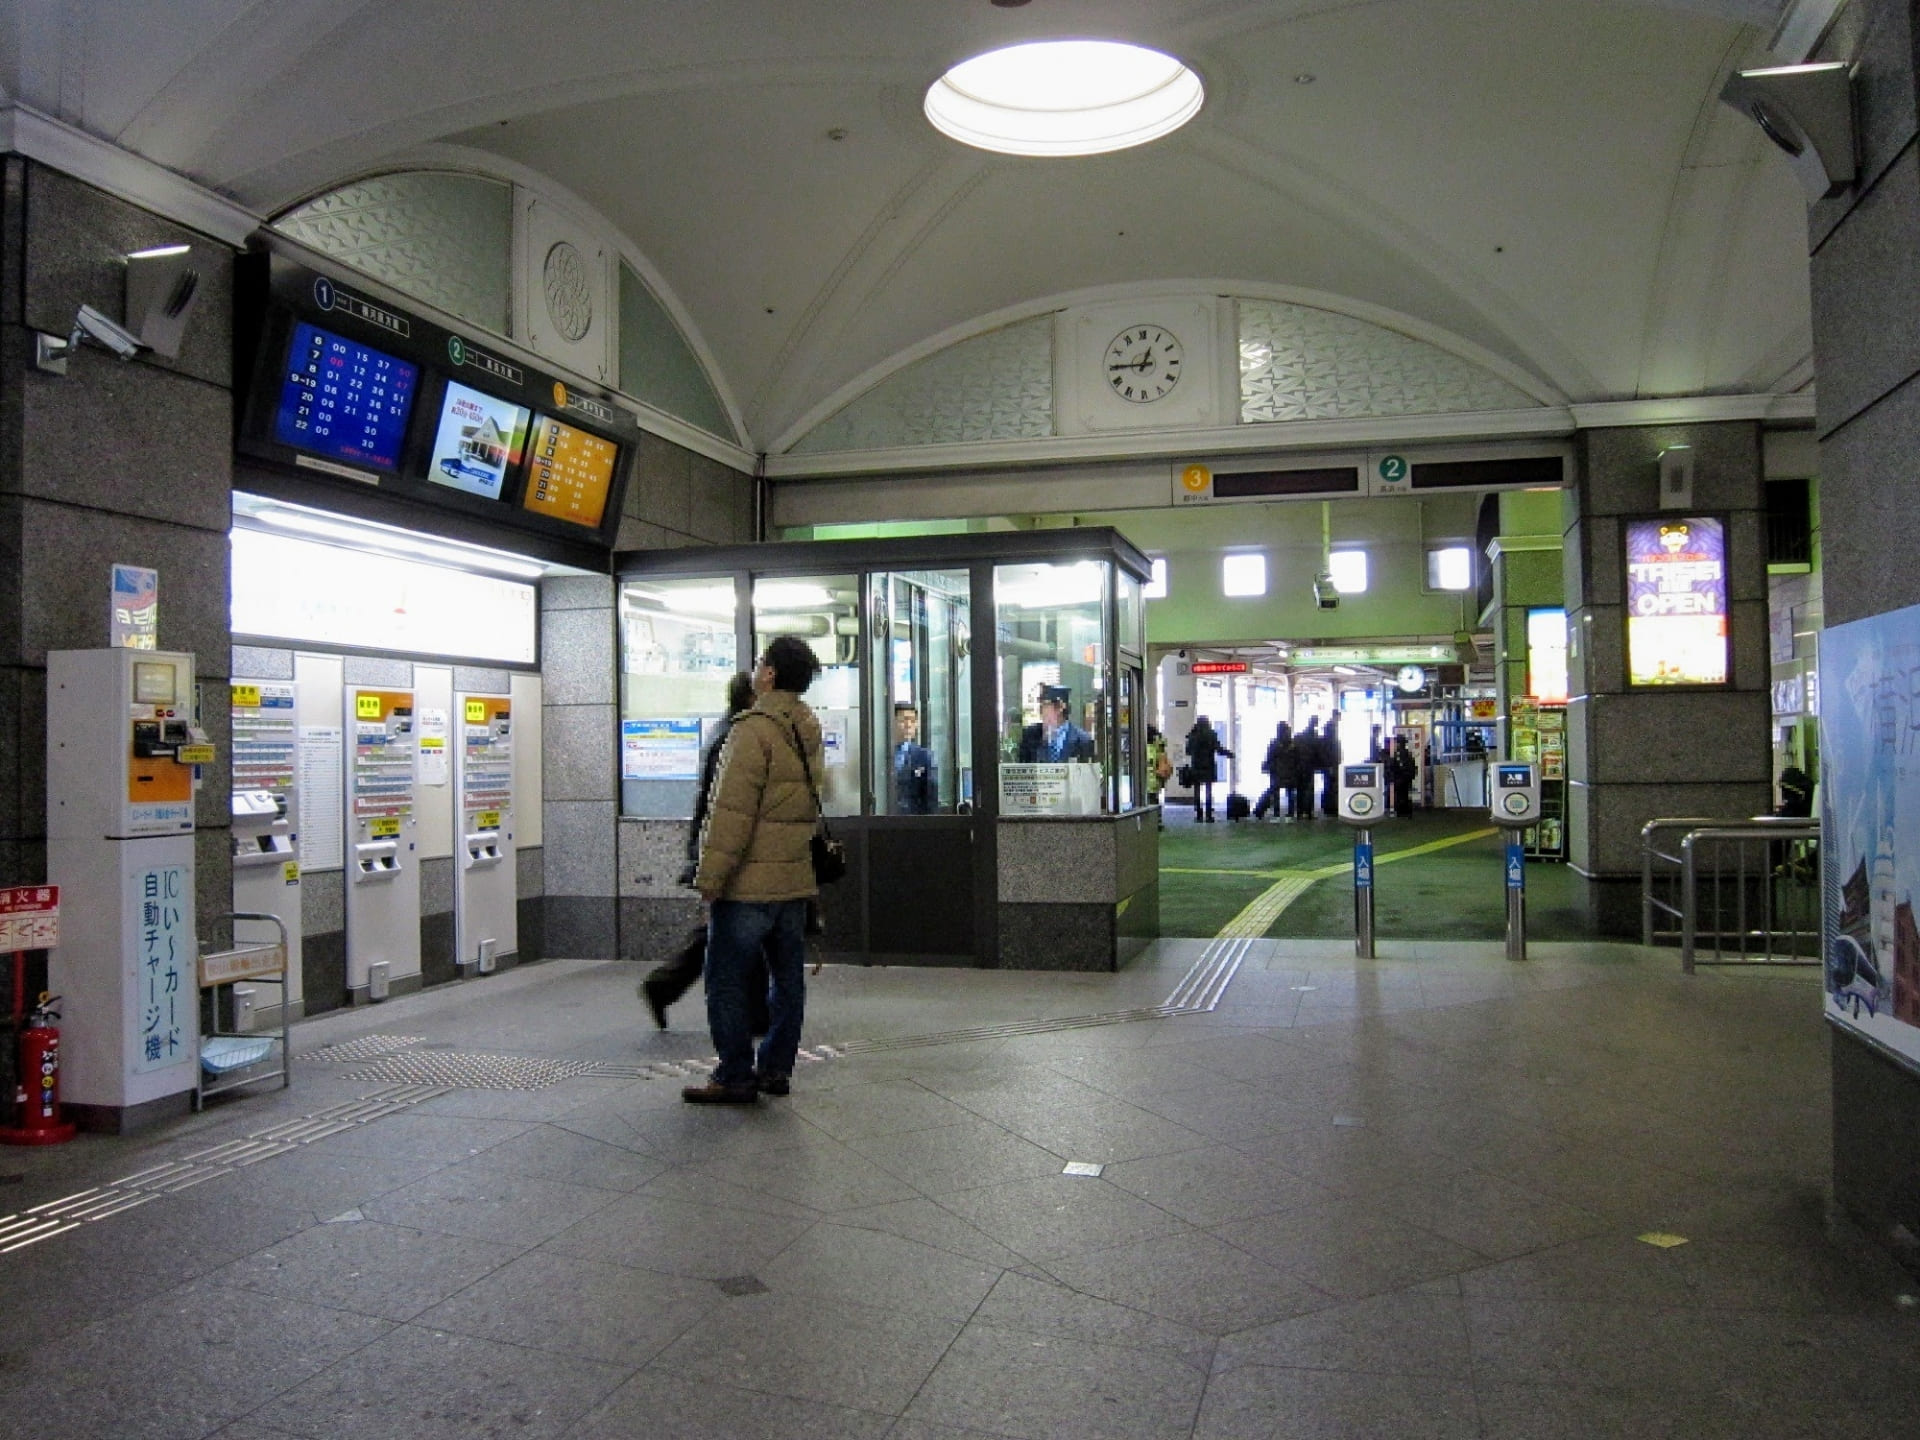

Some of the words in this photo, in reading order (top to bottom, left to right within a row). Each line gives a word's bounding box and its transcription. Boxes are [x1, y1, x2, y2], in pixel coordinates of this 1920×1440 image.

[314, 336, 323, 346] 6
[332, 343, 346, 354] 00
[356, 351, 369, 362] 15
[377, 359, 390, 370] 37
[308, 364, 317, 374] 8
[326, 370, 340, 381] 01
[349, 378, 363, 389] 22
[311, 349, 320, 359] 7
[353, 365, 366, 376] 12
[374, 372, 387, 383] 34
[300, 391, 314, 402] 20
[343, 405, 357, 416] 21
[346, 392, 359, 402] 21
[389, 406, 401, 416] 51
[297, 405, 310, 416] 21
[317, 411, 332, 422] 00
[363, 425, 377, 436] 30
[294, 419, 308, 430] 22
[314, 425, 329, 437] 00
[361, 439, 375, 449] 30
[1190, 470, 1202, 487] 3
[1387, 459, 1400, 477] 2
[1637, 592, 1716, 615] OPEN
[1357, 856, 1370, 880] 入場
[1508, 857, 1522, 881] 入場
[0, 888, 51, 905] 消火器
[144, 874, 162, 1062] 自動チャージ機
